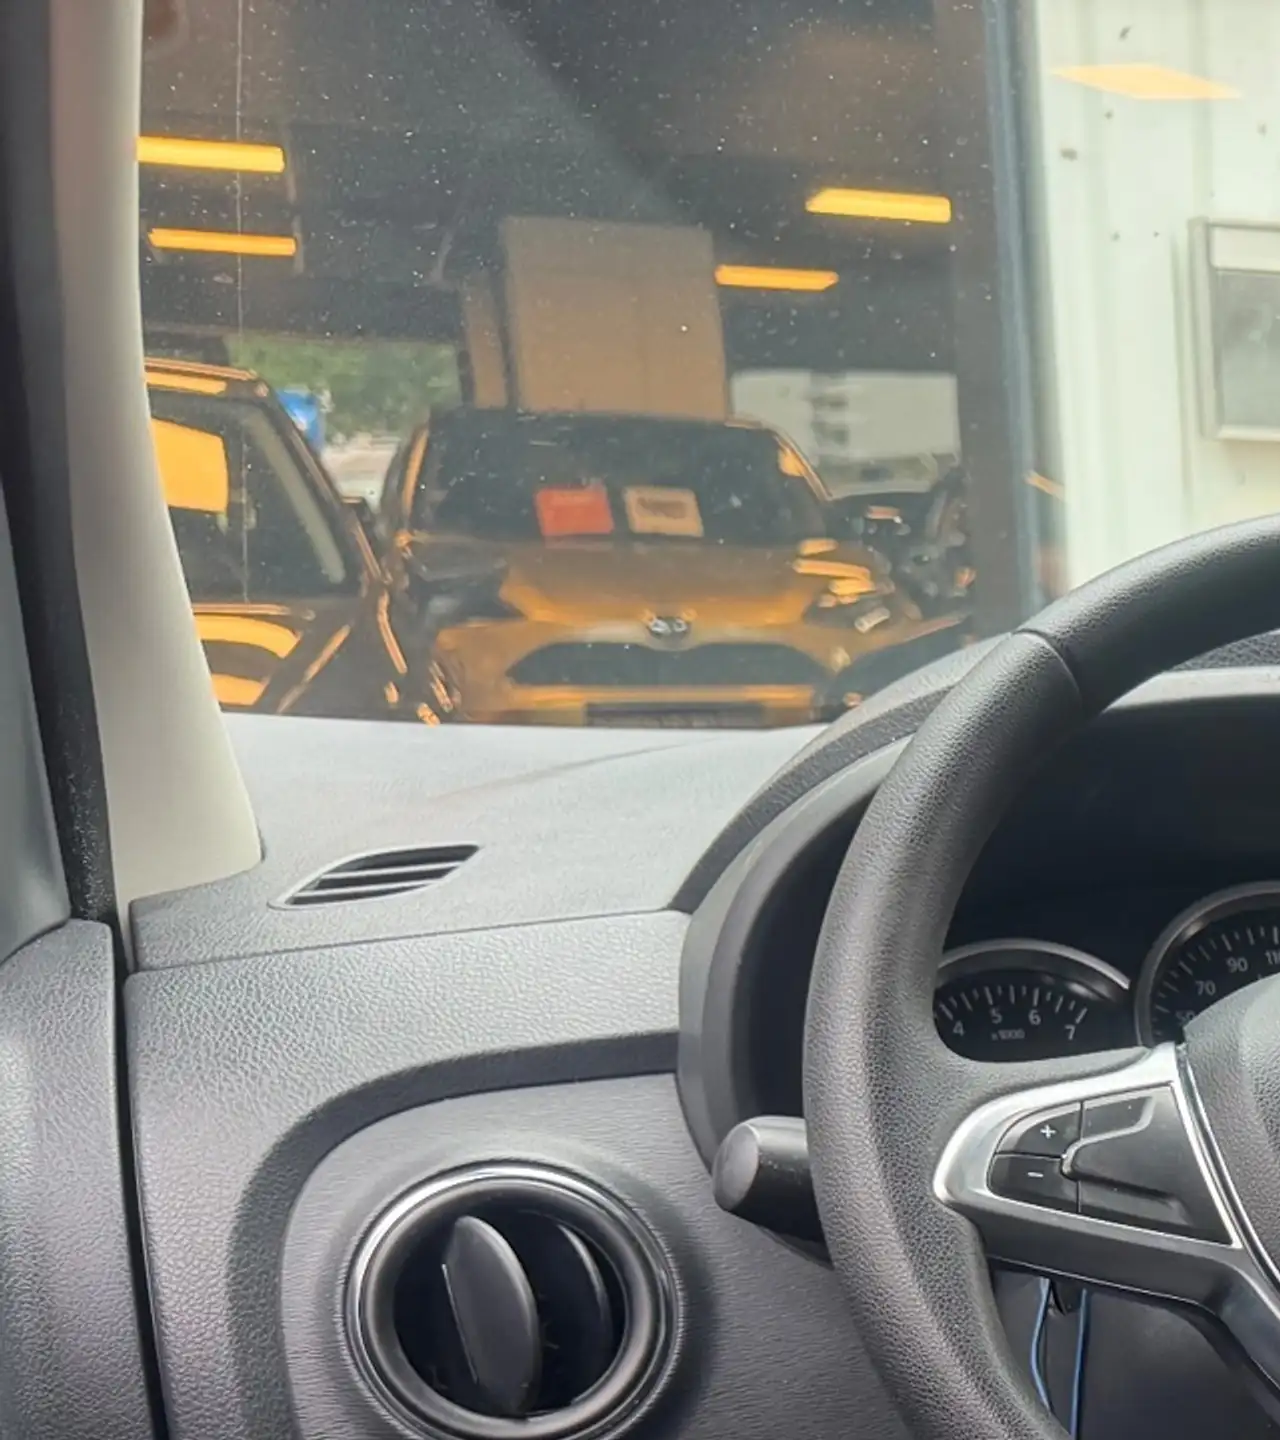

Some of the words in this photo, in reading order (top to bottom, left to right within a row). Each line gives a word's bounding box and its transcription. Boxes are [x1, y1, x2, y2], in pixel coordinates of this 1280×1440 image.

[1226, 956, 1249, 974] 90
[1195, 979, 1217, 997] 70
[990, 1008, 1003, 1024] 5
[1028, 1009, 1042, 1026] 6
[952, 1019, 965, 1036] 4
[1064, 1024, 1076, 1041] 7
